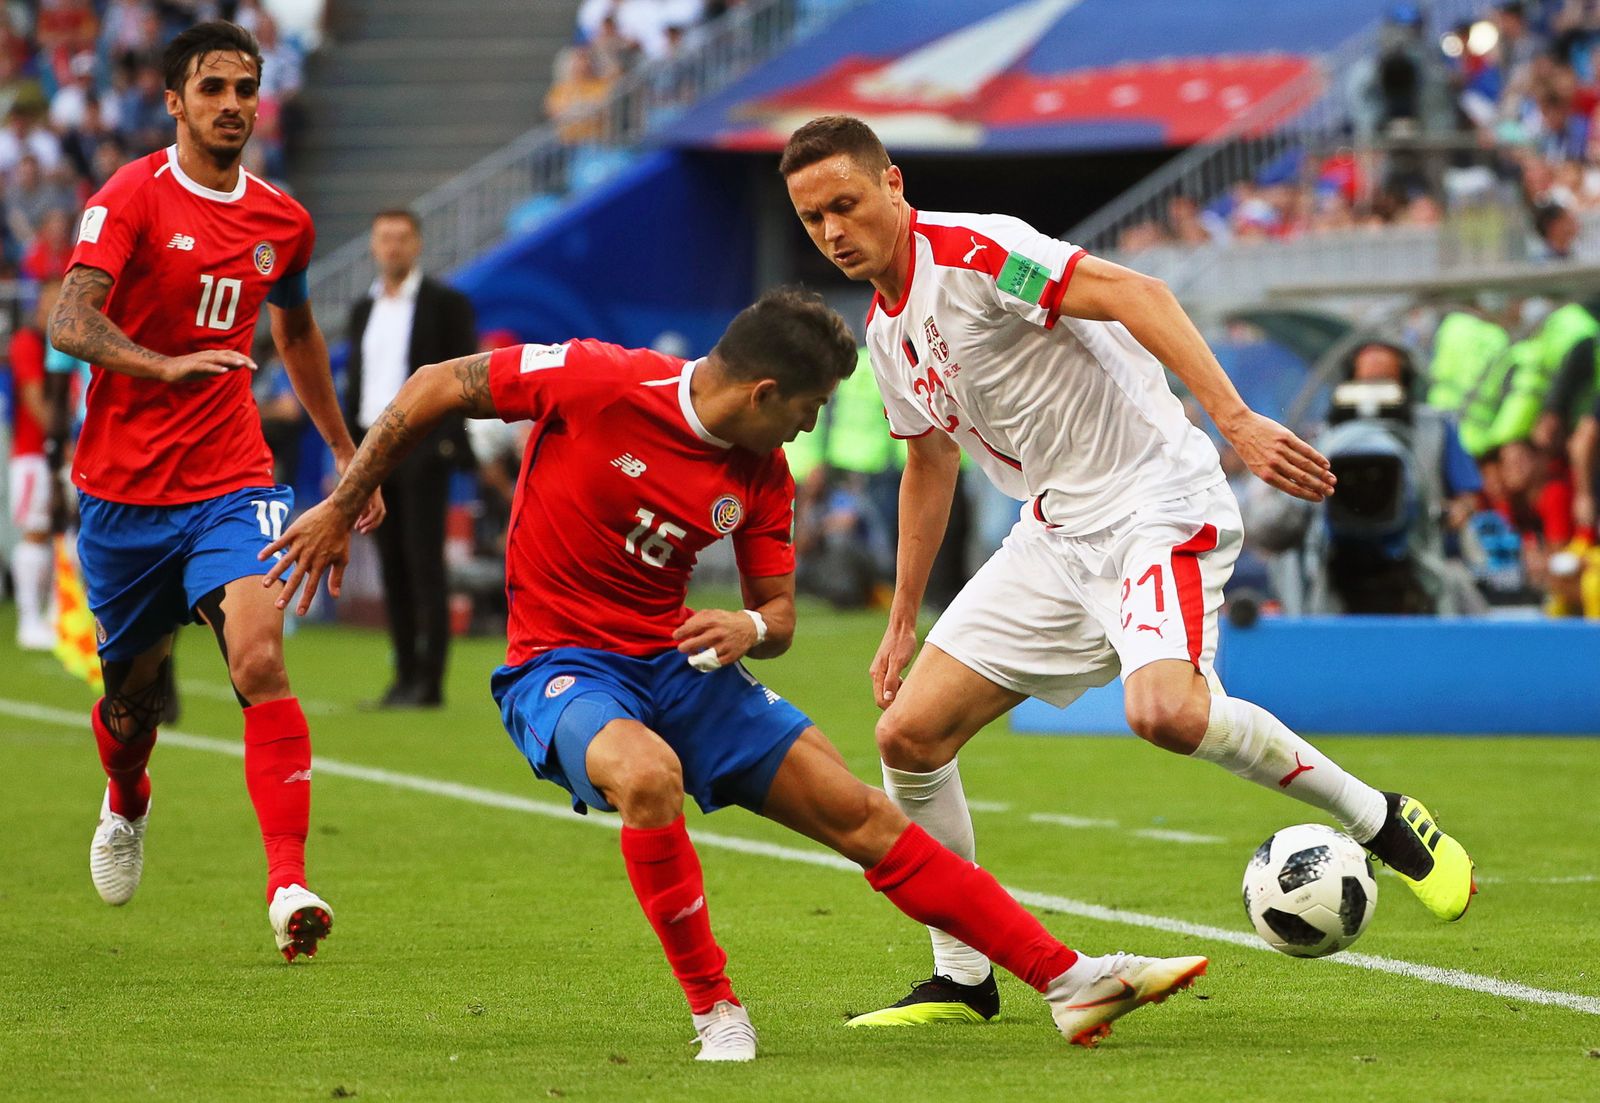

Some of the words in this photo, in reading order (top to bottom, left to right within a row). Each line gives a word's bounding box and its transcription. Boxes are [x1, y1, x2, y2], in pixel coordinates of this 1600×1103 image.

[195, 273, 243, 331] 10
[250, 500, 290, 561] 10
[624, 507, 688, 569] 16
